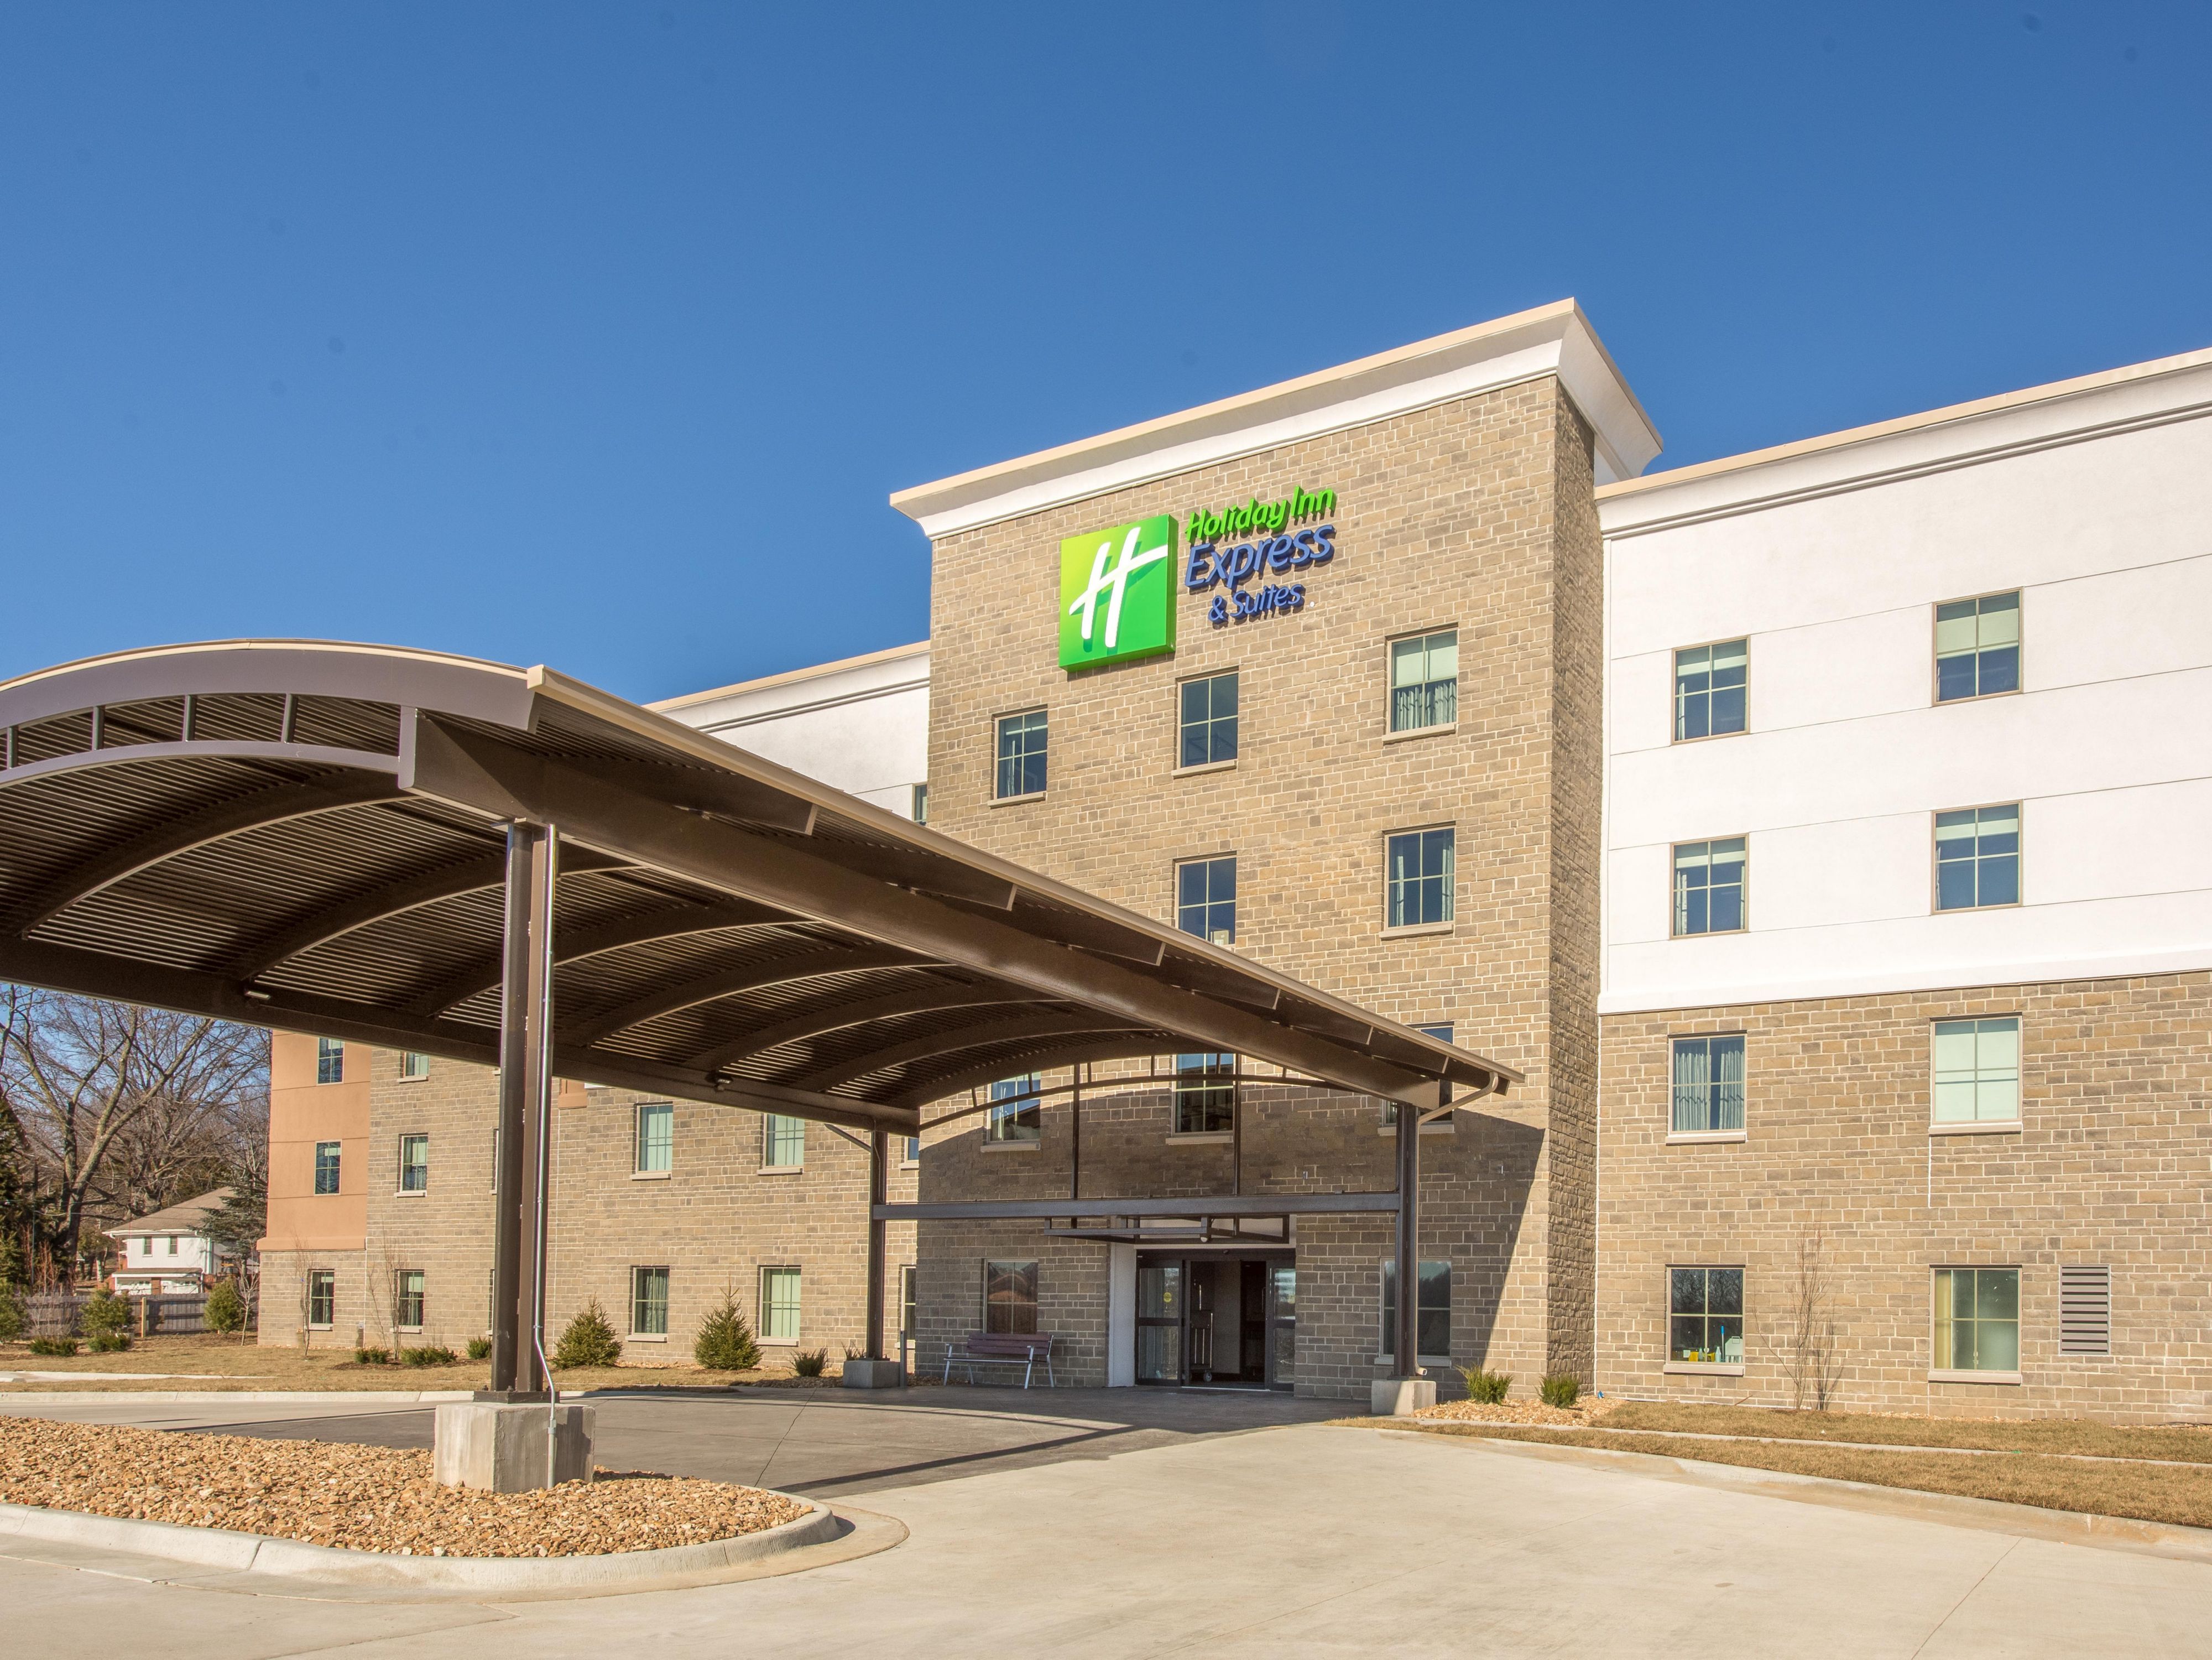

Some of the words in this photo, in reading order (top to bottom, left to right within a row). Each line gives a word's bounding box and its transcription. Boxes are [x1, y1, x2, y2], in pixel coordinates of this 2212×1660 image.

[1185, 498, 1289, 543] Holiday
[1290, 486, 1337, 518] Inn
[1185, 524, 1335, 590] Express
[1208, 595, 1228, 623] &
[1230, 584, 1306, 618] Suites
